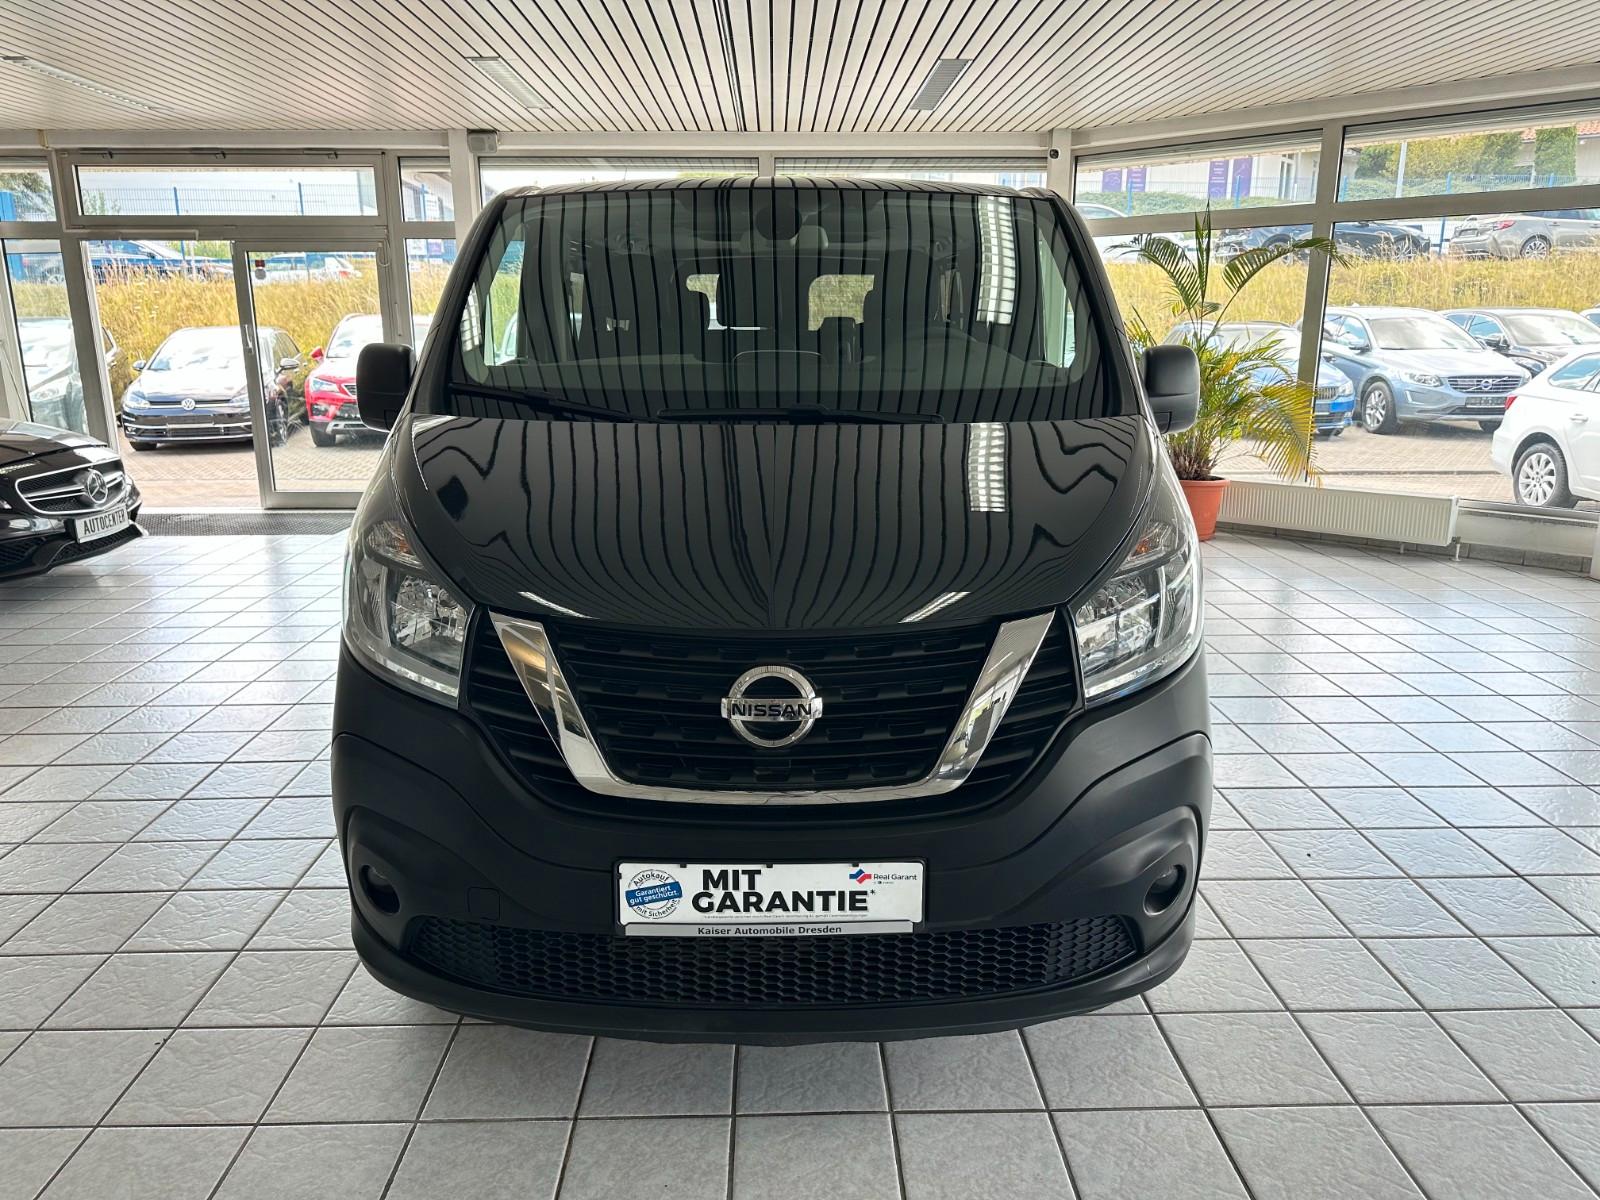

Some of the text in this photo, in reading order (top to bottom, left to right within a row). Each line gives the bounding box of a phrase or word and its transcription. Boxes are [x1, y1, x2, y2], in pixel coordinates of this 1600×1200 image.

[84, 509, 125, 535] AUTOCENTER
[731, 703, 812, 717] NISSAN
[633, 871, 670, 887] Autokauf
[702, 869, 761, 891] MIT
[890, 873, 917, 881] Garant
[635, 885, 671, 897] Garantiert
[629, 897, 643, 906] gut
[636, 906, 648, 915] mit
[698, 925, 842, 935] Kaiser Automobile Dresden
